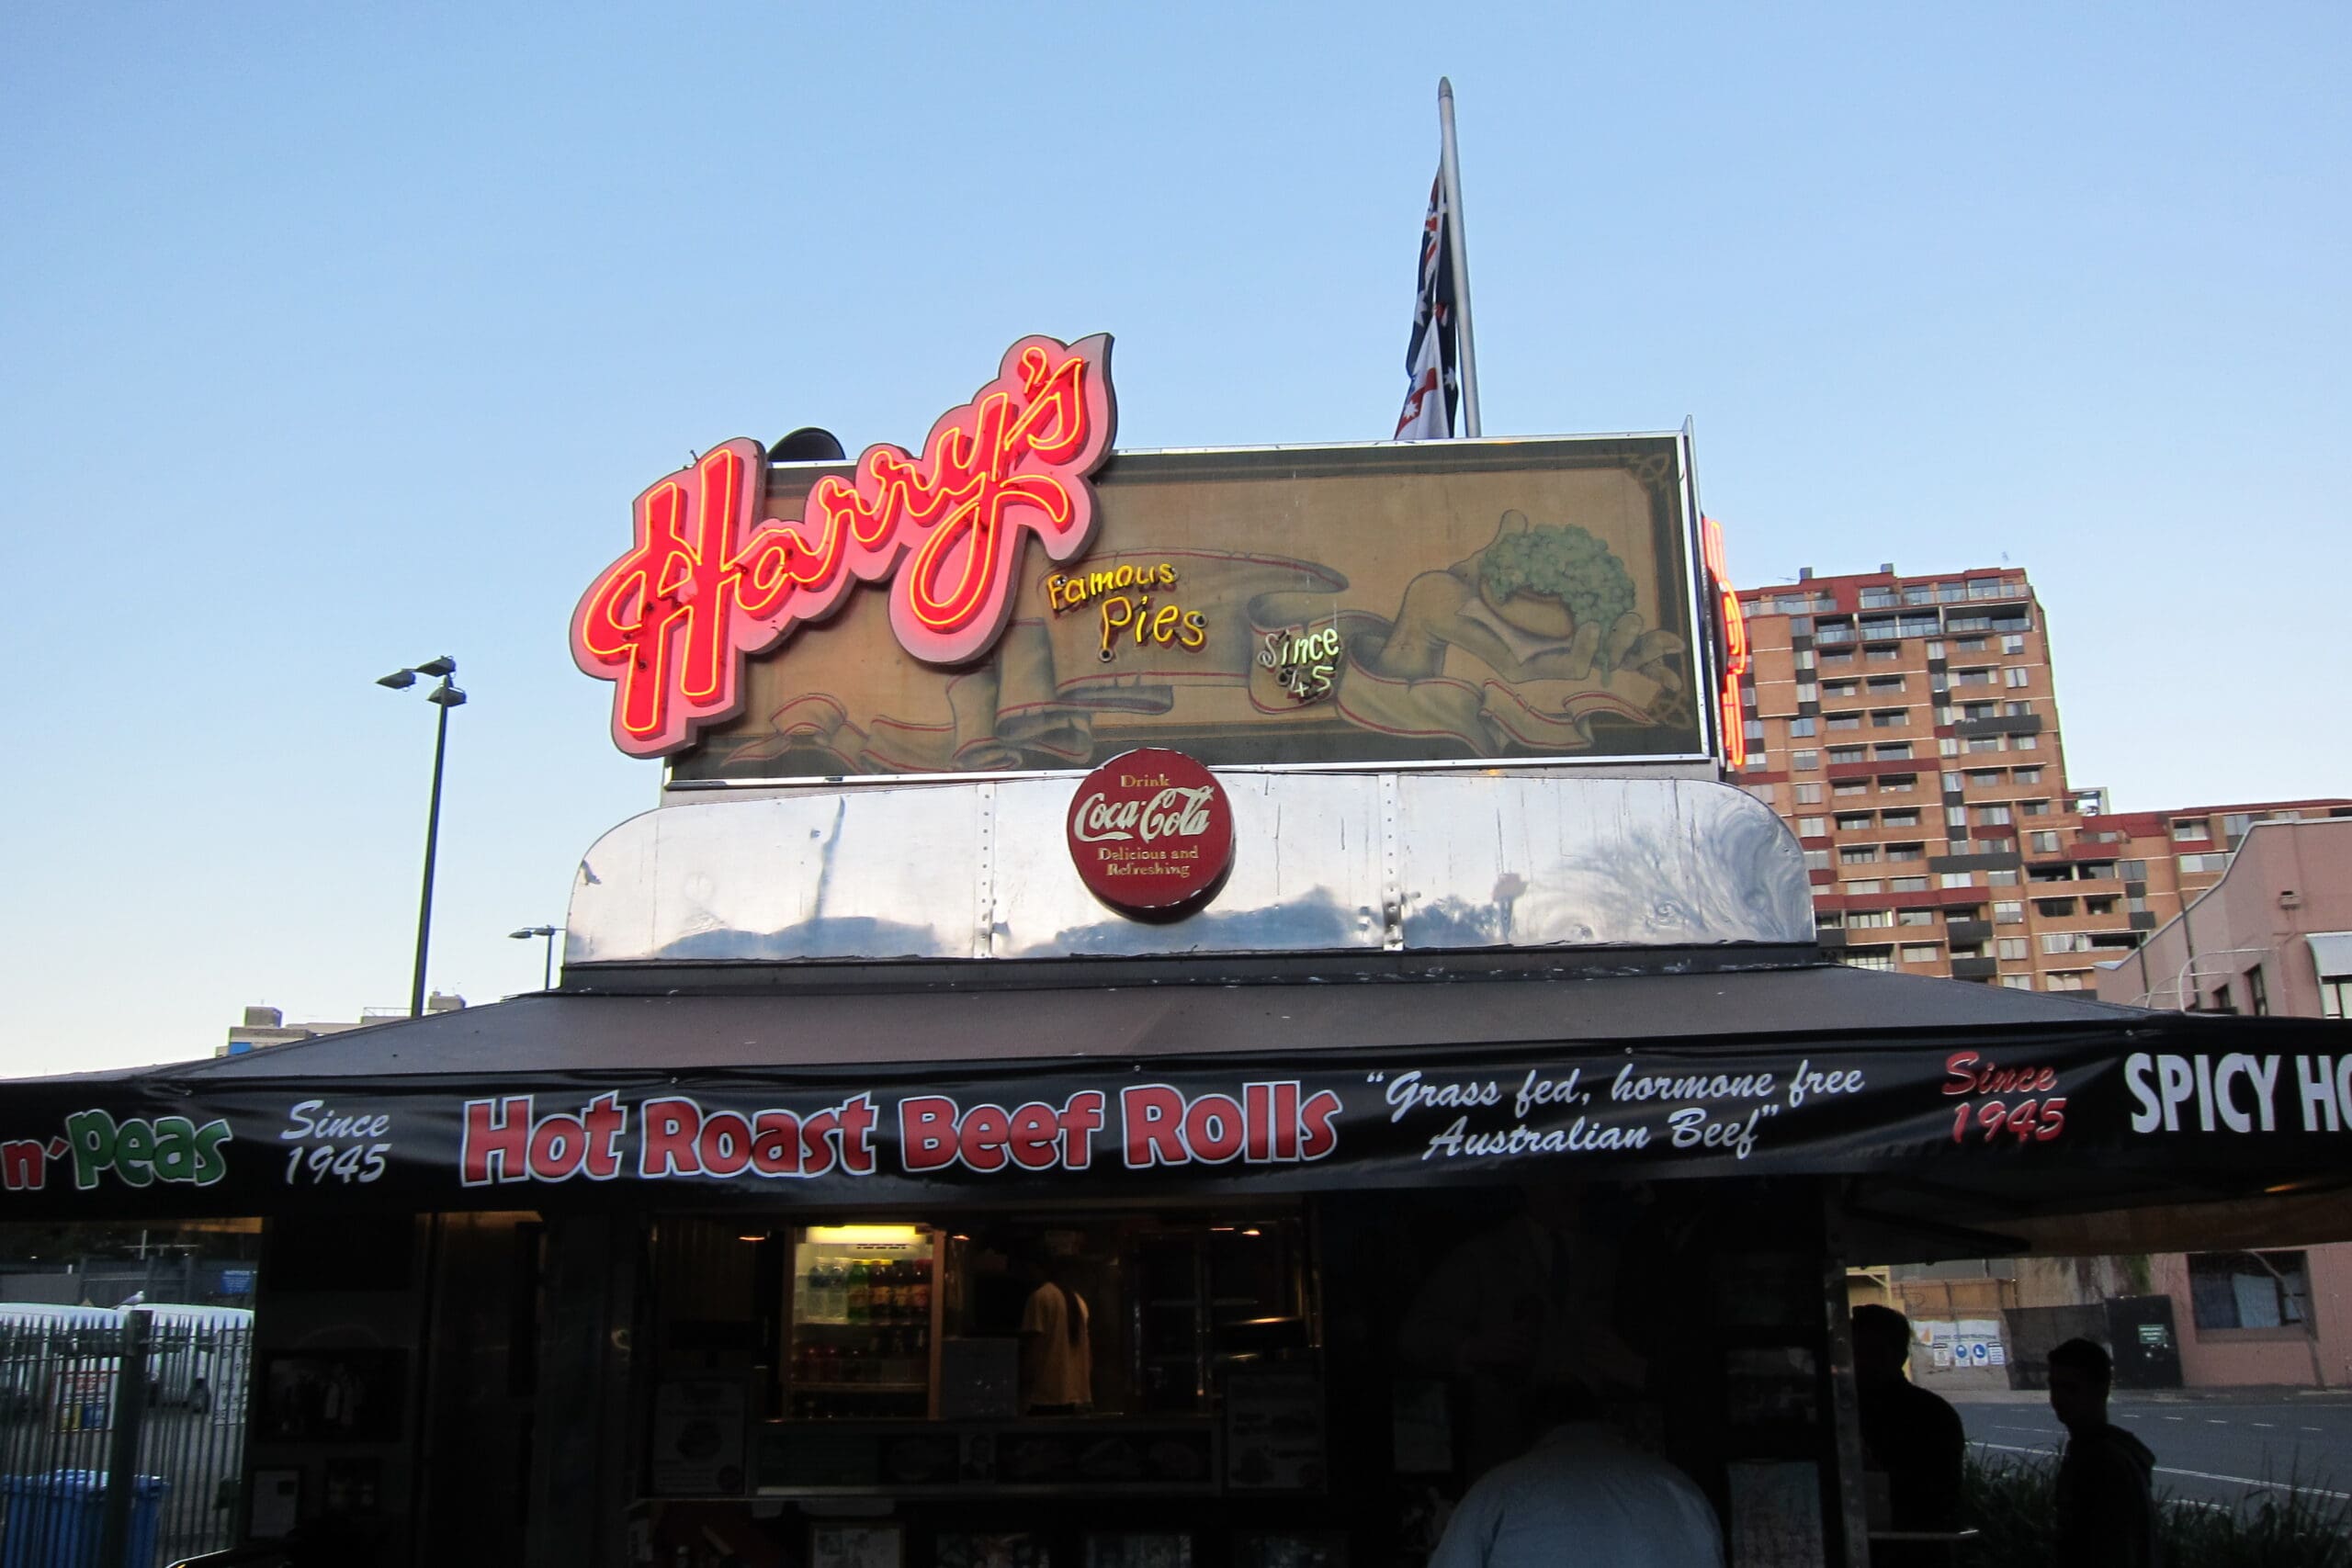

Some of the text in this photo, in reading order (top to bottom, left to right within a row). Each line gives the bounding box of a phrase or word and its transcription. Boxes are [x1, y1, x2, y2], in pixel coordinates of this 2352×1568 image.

[582, 345, 1091, 740] Harry's
[1047, 563, 1177, 611] Famous
[1102, 595, 1205, 654] Pies
[1257, 627, 1340, 669] Since
[1120, 773, 1171, 788] Drink
[1074, 785, 1216, 843] Coca-Cola
[1097, 846, 1199, 861] Delicious and
[1106, 863, 1191, 878] Refreshing
[1366, 1058, 1866, 1123] "Grass fed, hormone free
[1940, 1050, 2059, 1096] Since
[2124, 1052, 2282, 1134] SPICY
[280, 1099, 391, 1141] Since
[461, 1080, 1343, 1188] Hot Roast Beef Rolls
[1421, 1104, 1780, 1161] Australian Beef"
[1954, 1097, 2067, 1145] 1945
[285, 1142, 393, 1186] 1945
